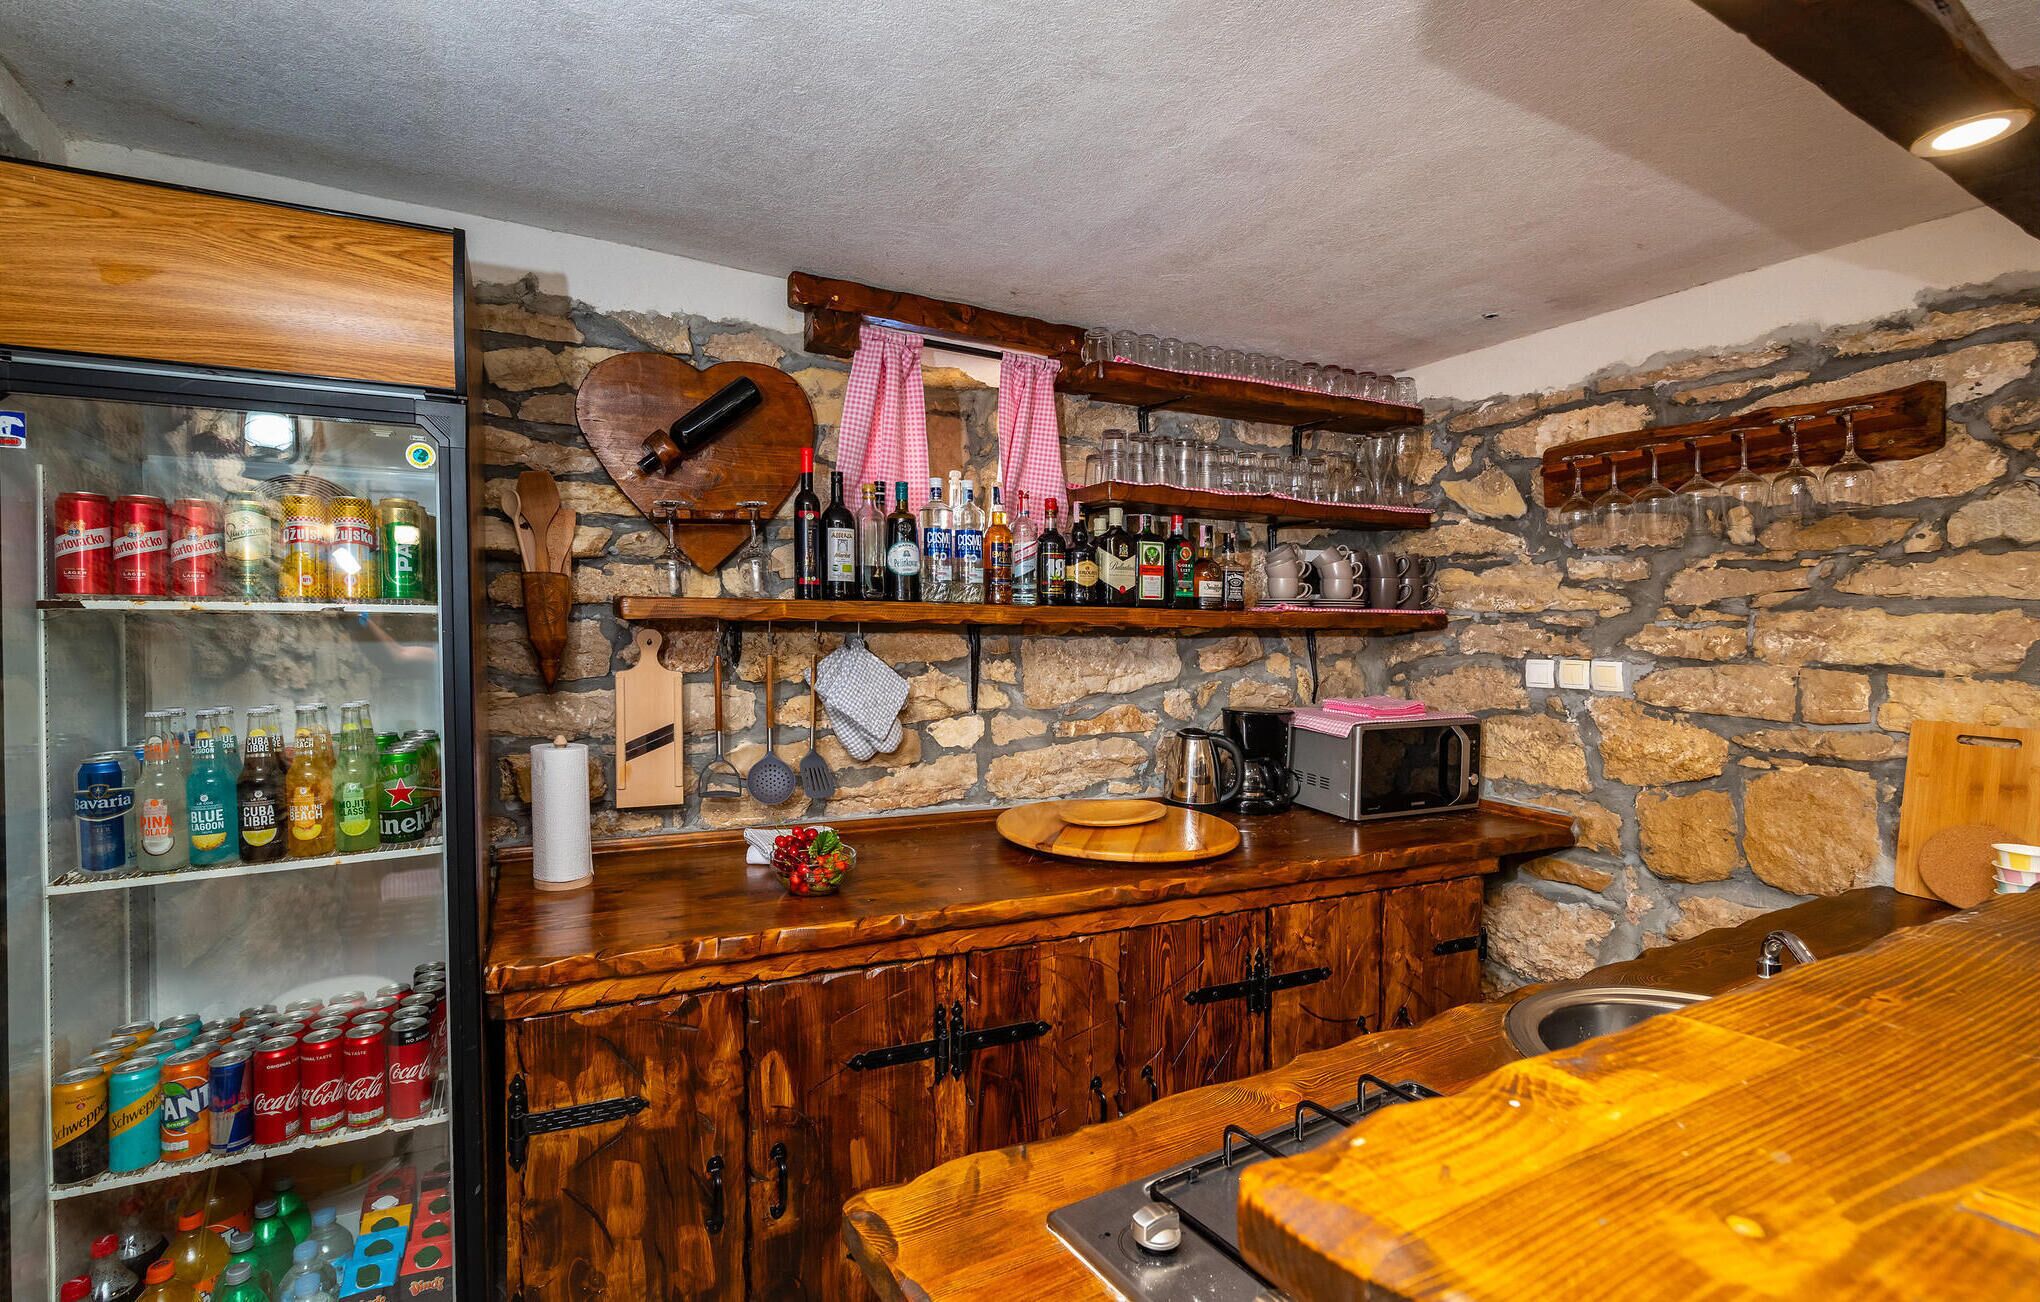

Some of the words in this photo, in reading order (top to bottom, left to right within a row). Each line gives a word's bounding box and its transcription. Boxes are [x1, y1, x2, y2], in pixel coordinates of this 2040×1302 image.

[55, 533, 105, 553] arlovačko
[283, 526, 324, 543] Ožujs
[334, 527, 373, 545] žujsko
[74, 793, 132, 811] Bavaria
[243, 804, 275, 817] CUBA
[190, 808, 224, 824] BLUE
[243, 814, 276, 827] LIBRE
[289, 809, 323, 821] BEACH
[191, 820, 225, 832] LAGOON
[379, 814, 424, 835] inek
[161, 1083, 210, 1121] ANT
[53, 1098, 108, 1142] Schweppe
[111, 1094, 160, 1132] Schwepp
